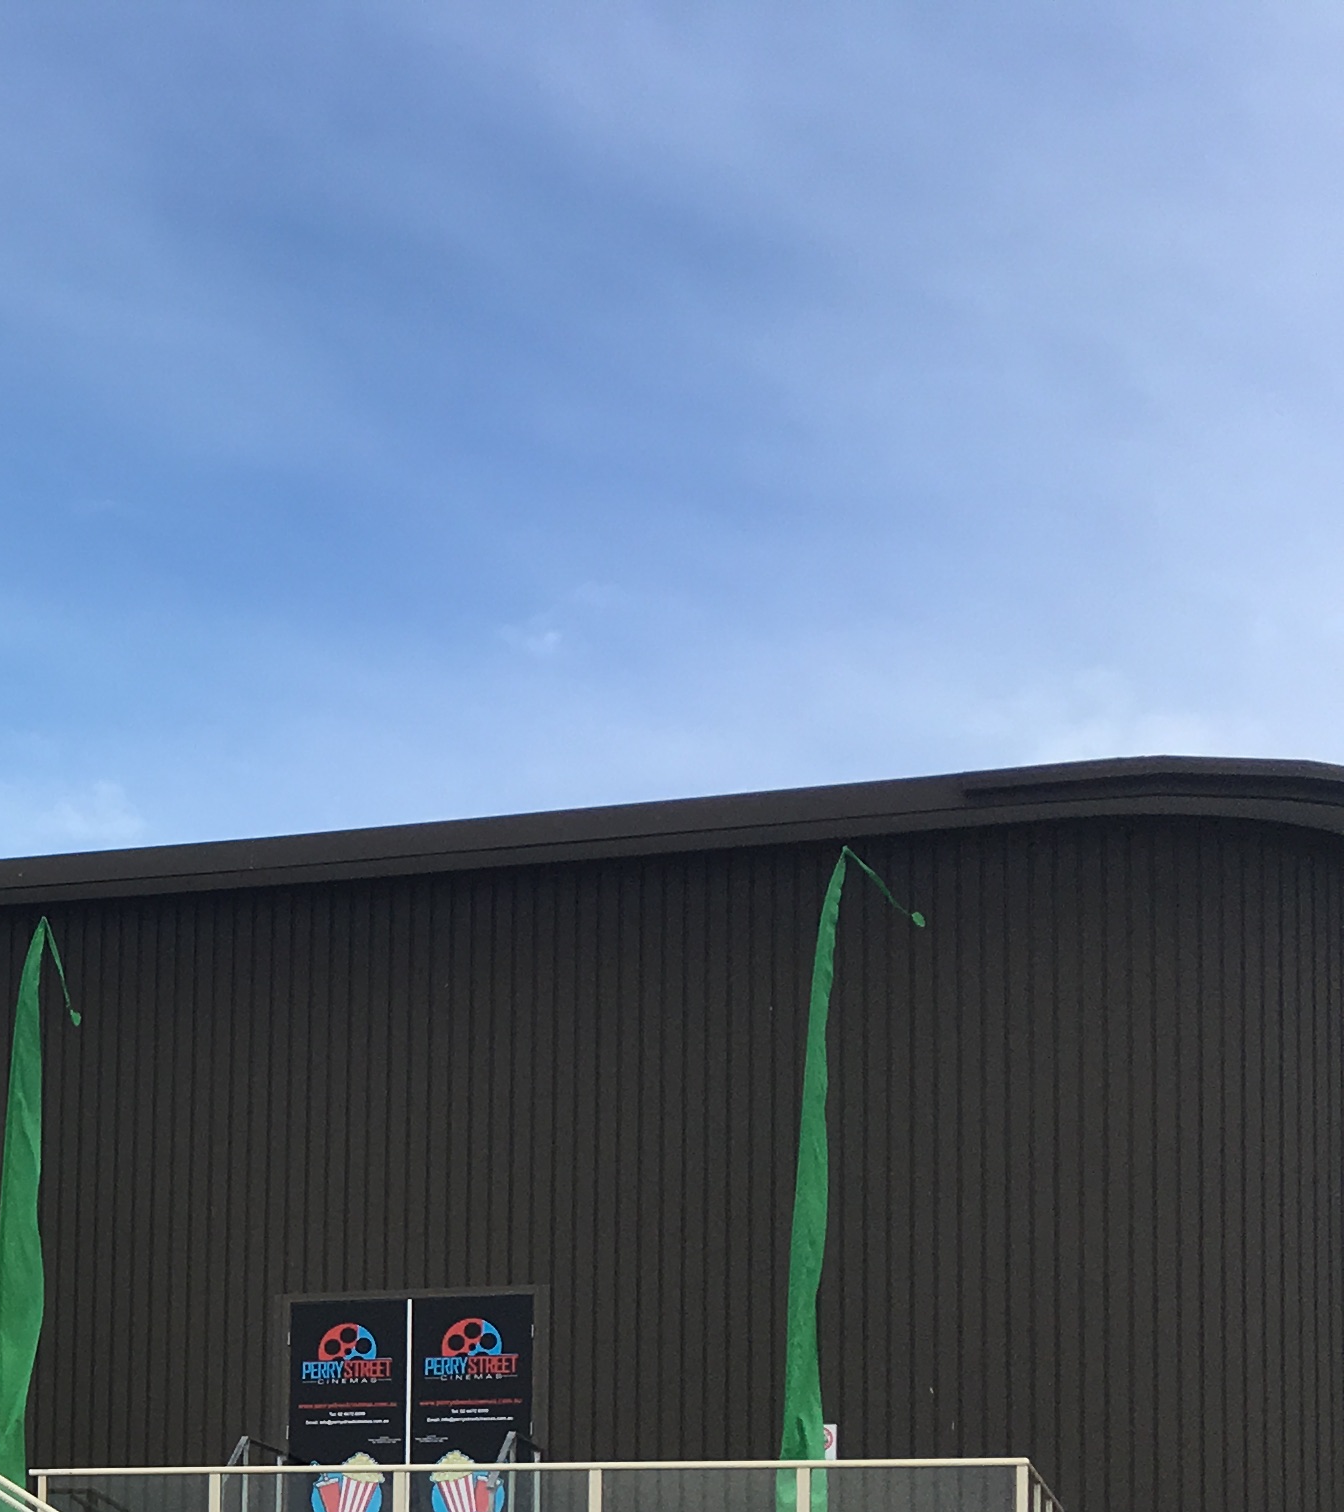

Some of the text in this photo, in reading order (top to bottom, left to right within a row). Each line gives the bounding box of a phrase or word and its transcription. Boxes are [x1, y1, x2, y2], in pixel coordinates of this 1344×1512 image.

[302, 1358, 393, 1380] PERRY STREET
[425, 1354, 519, 1376] PERRY STREET
[317, 1378, 378, 1386] CINEMAS
[440, 1373, 503, 1382] CINEMAS
